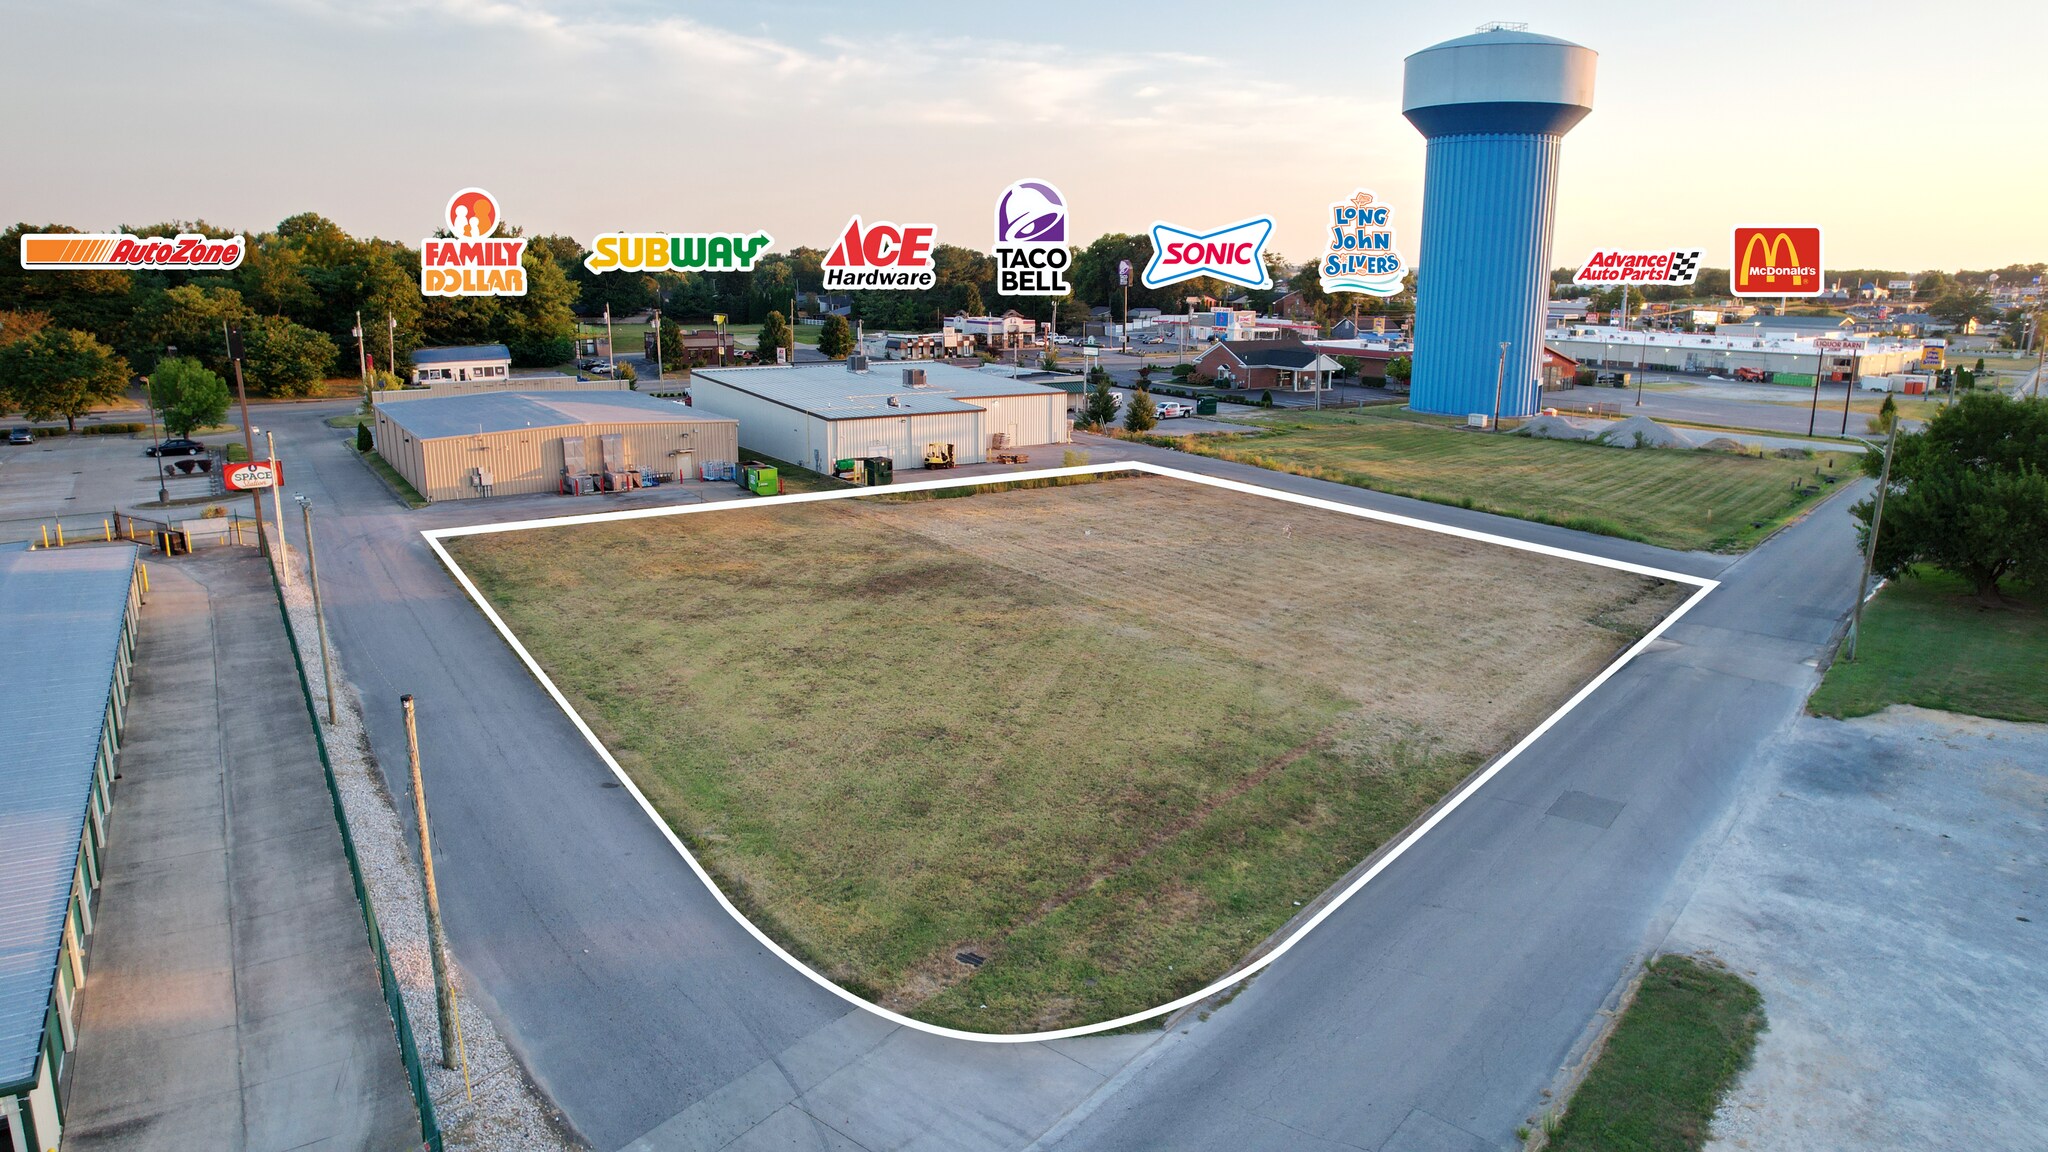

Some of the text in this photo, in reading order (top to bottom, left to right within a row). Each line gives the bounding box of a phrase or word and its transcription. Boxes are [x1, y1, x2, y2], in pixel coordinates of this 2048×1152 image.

[1816, 340, 1842, 348] LIQUOR
[1842, 341, 1862, 349] BARN
[234, 471, 273, 482] SPACE
